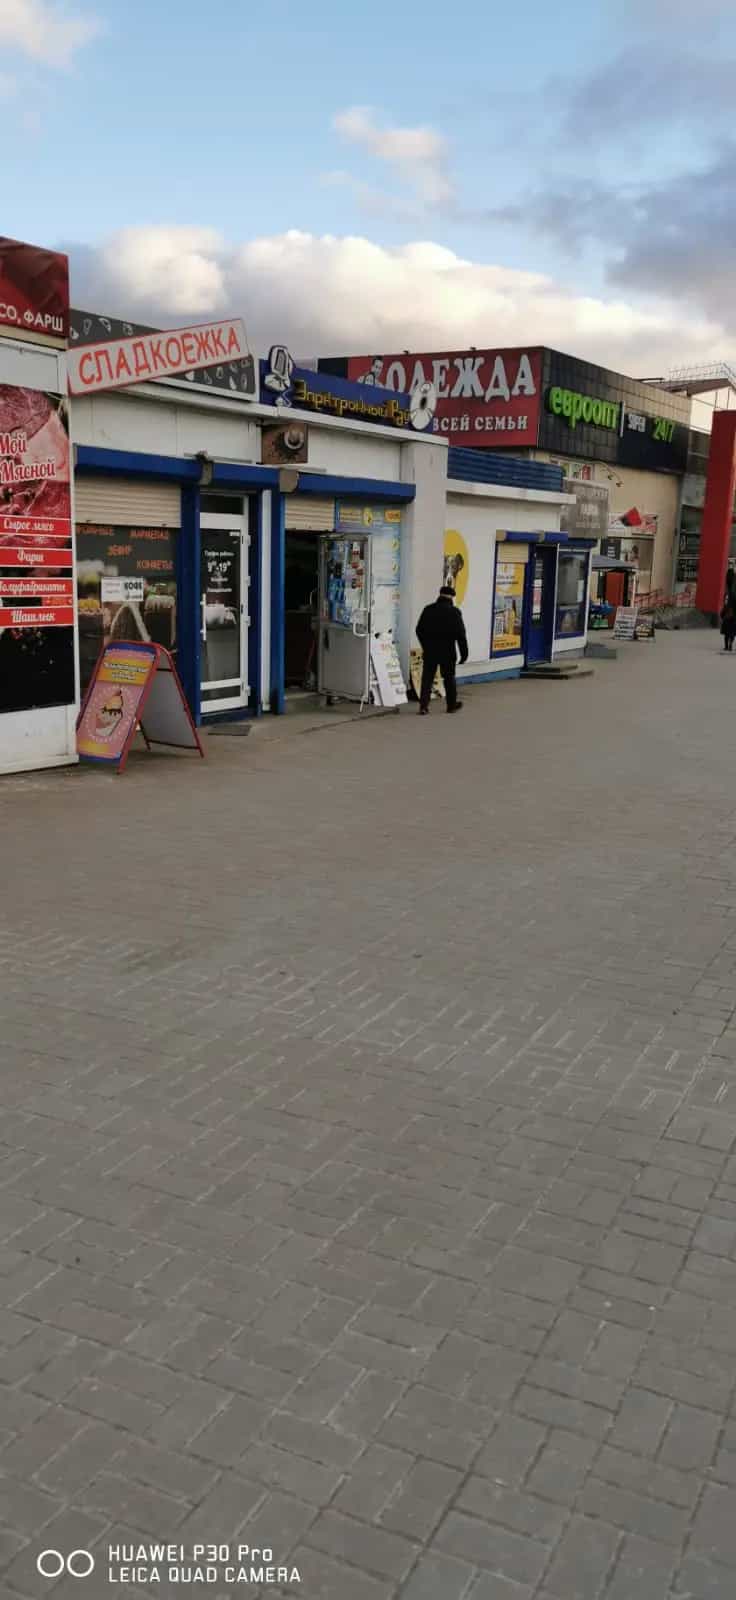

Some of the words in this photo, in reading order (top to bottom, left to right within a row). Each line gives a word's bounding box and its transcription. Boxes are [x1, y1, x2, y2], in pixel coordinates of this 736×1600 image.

[24, 310, 63, 332] ФАРШ
[79, 327, 241, 385] СЛАДКОЕЖКА
[385, 354, 536, 402] ОДЕЖДА
[432, 414, 470, 432] ВСЕЙ
[474, 415, 528, 431] СЕМЬИ
[0, 432, 26, 454] Мой
[1, 457, 56, 481] Мясной
[3, 518, 30, 532] Сырое
[17, 549, 44, 565] Фарш
